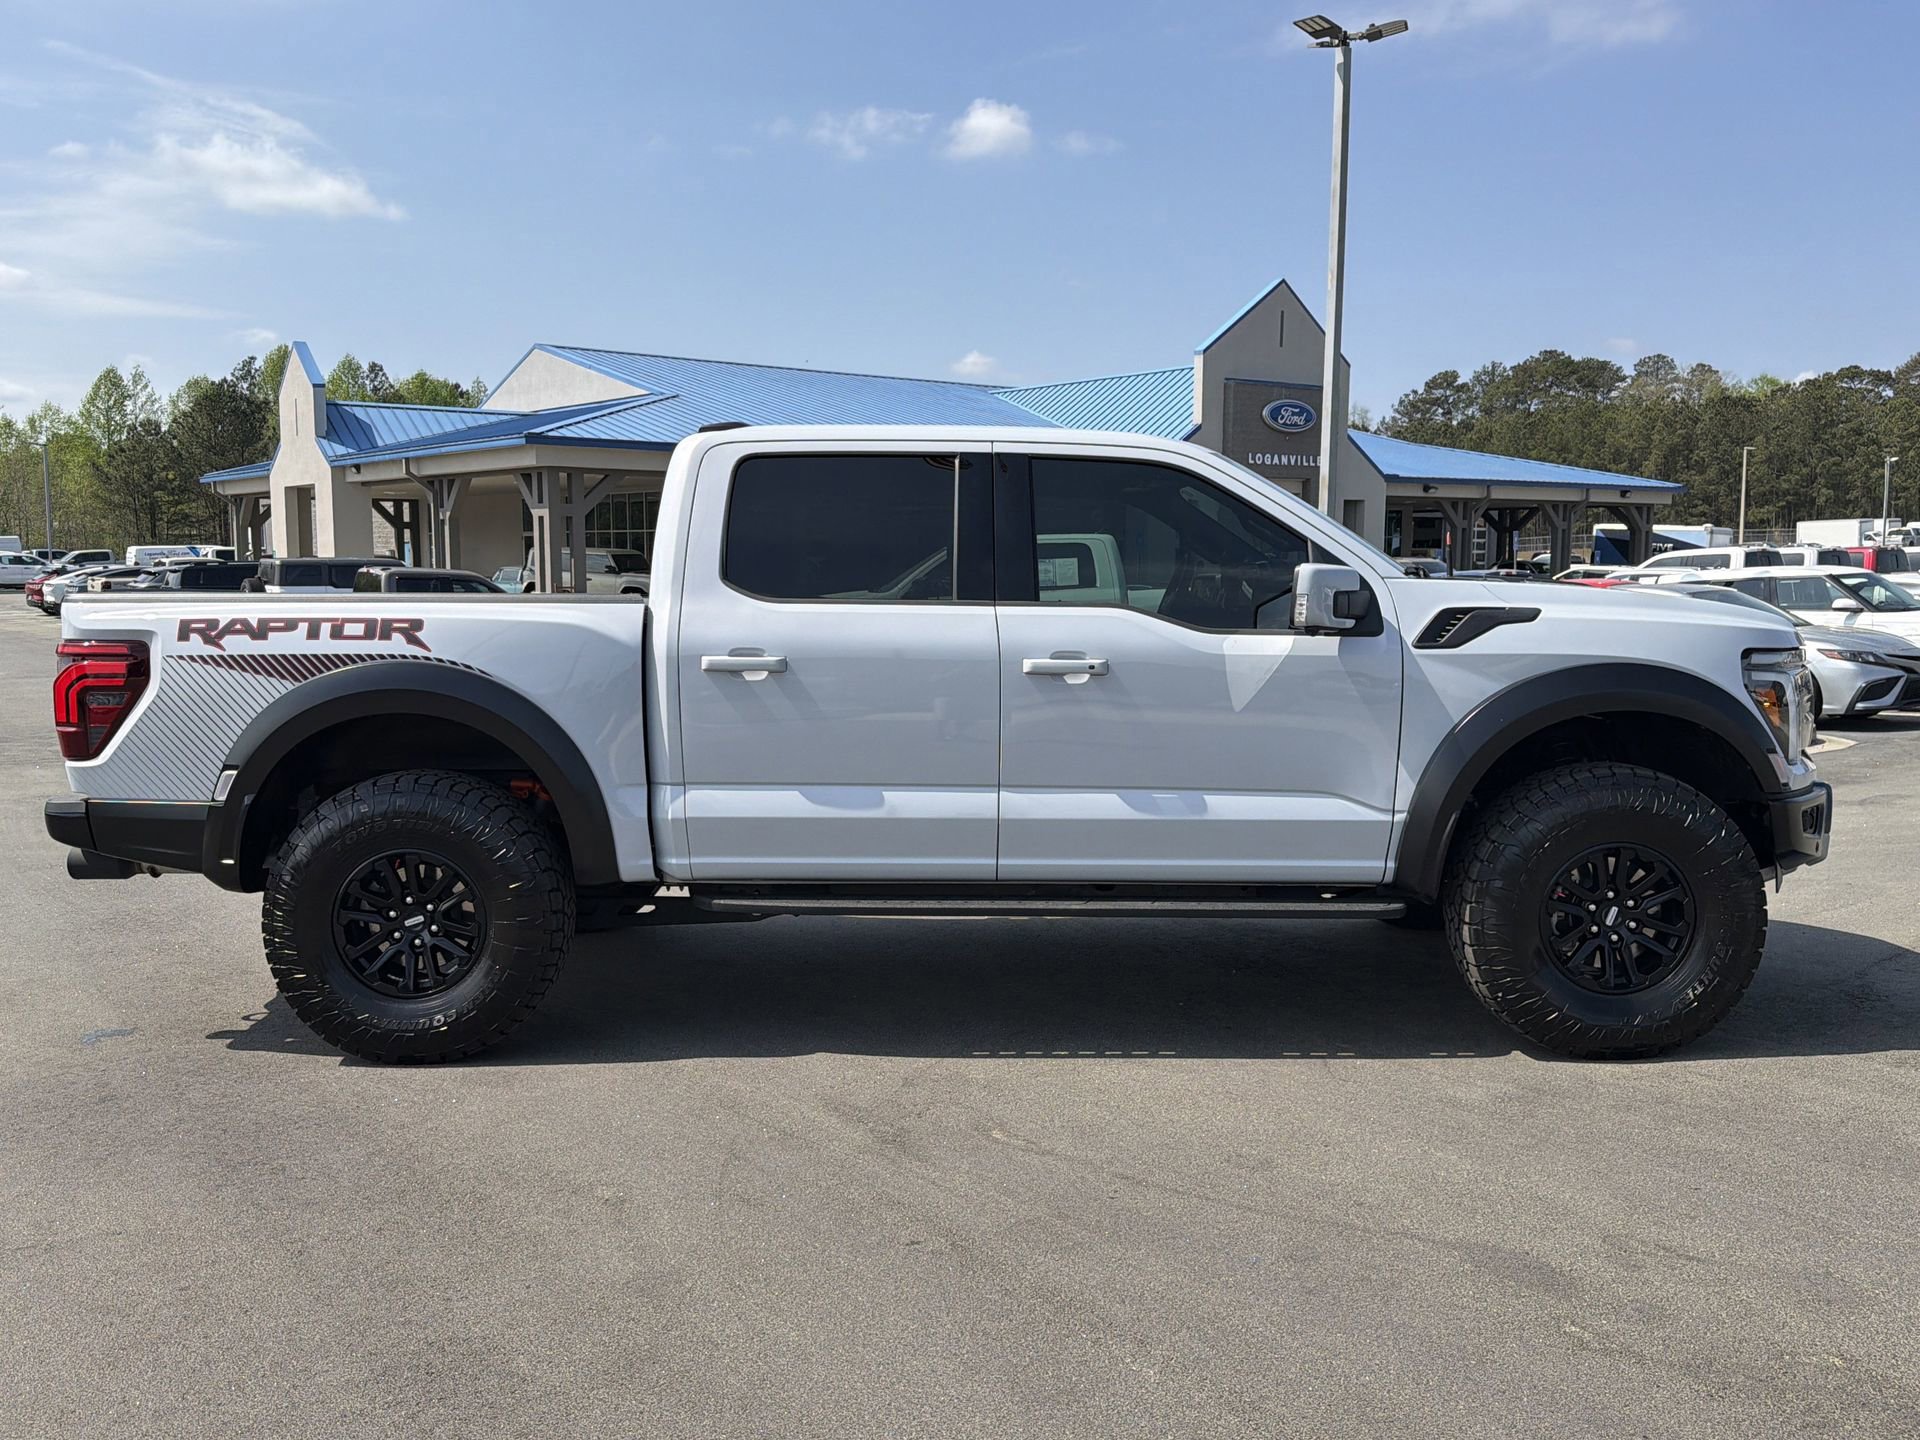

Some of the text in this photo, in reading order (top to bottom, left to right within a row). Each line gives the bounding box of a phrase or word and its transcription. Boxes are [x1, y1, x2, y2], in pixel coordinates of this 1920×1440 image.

[1277, 406, 1306, 425] Ford
[1248, 452, 1321, 466] LOGANVILLE
[176, 617, 432, 653] RAPTOR
